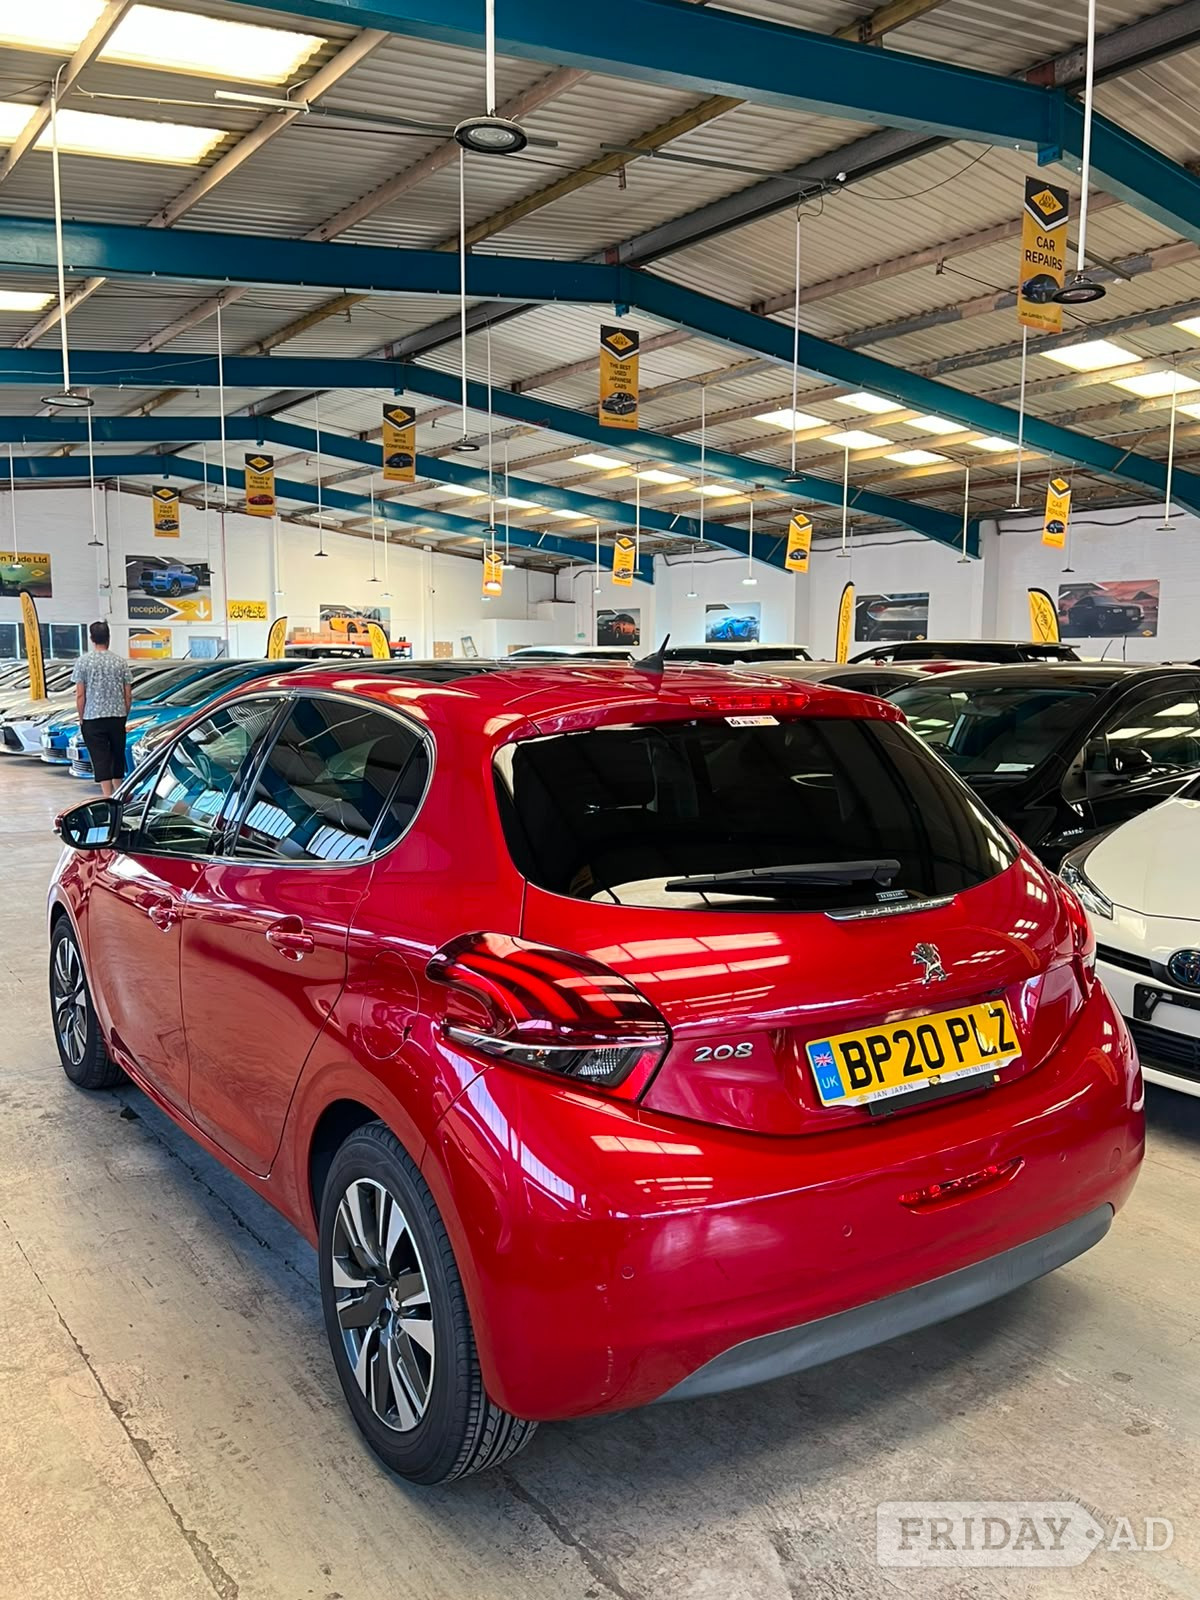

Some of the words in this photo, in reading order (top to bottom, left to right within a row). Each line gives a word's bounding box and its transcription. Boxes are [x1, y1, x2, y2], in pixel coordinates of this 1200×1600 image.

[1036, 235, 1056, 252] CAR
[1025, 249, 1063, 271] REPAIRS
[619, 363, 631, 371] BEST
[130, 605, 169, 614] reception
[693, 1042, 754, 1062] 208
[838, 1024, 945, 1090] BP20
[821, 1075, 839, 1089] UK
[873, 1090, 888, 1099] JAN
[891, 1083, 914, 1093] JAPAN
